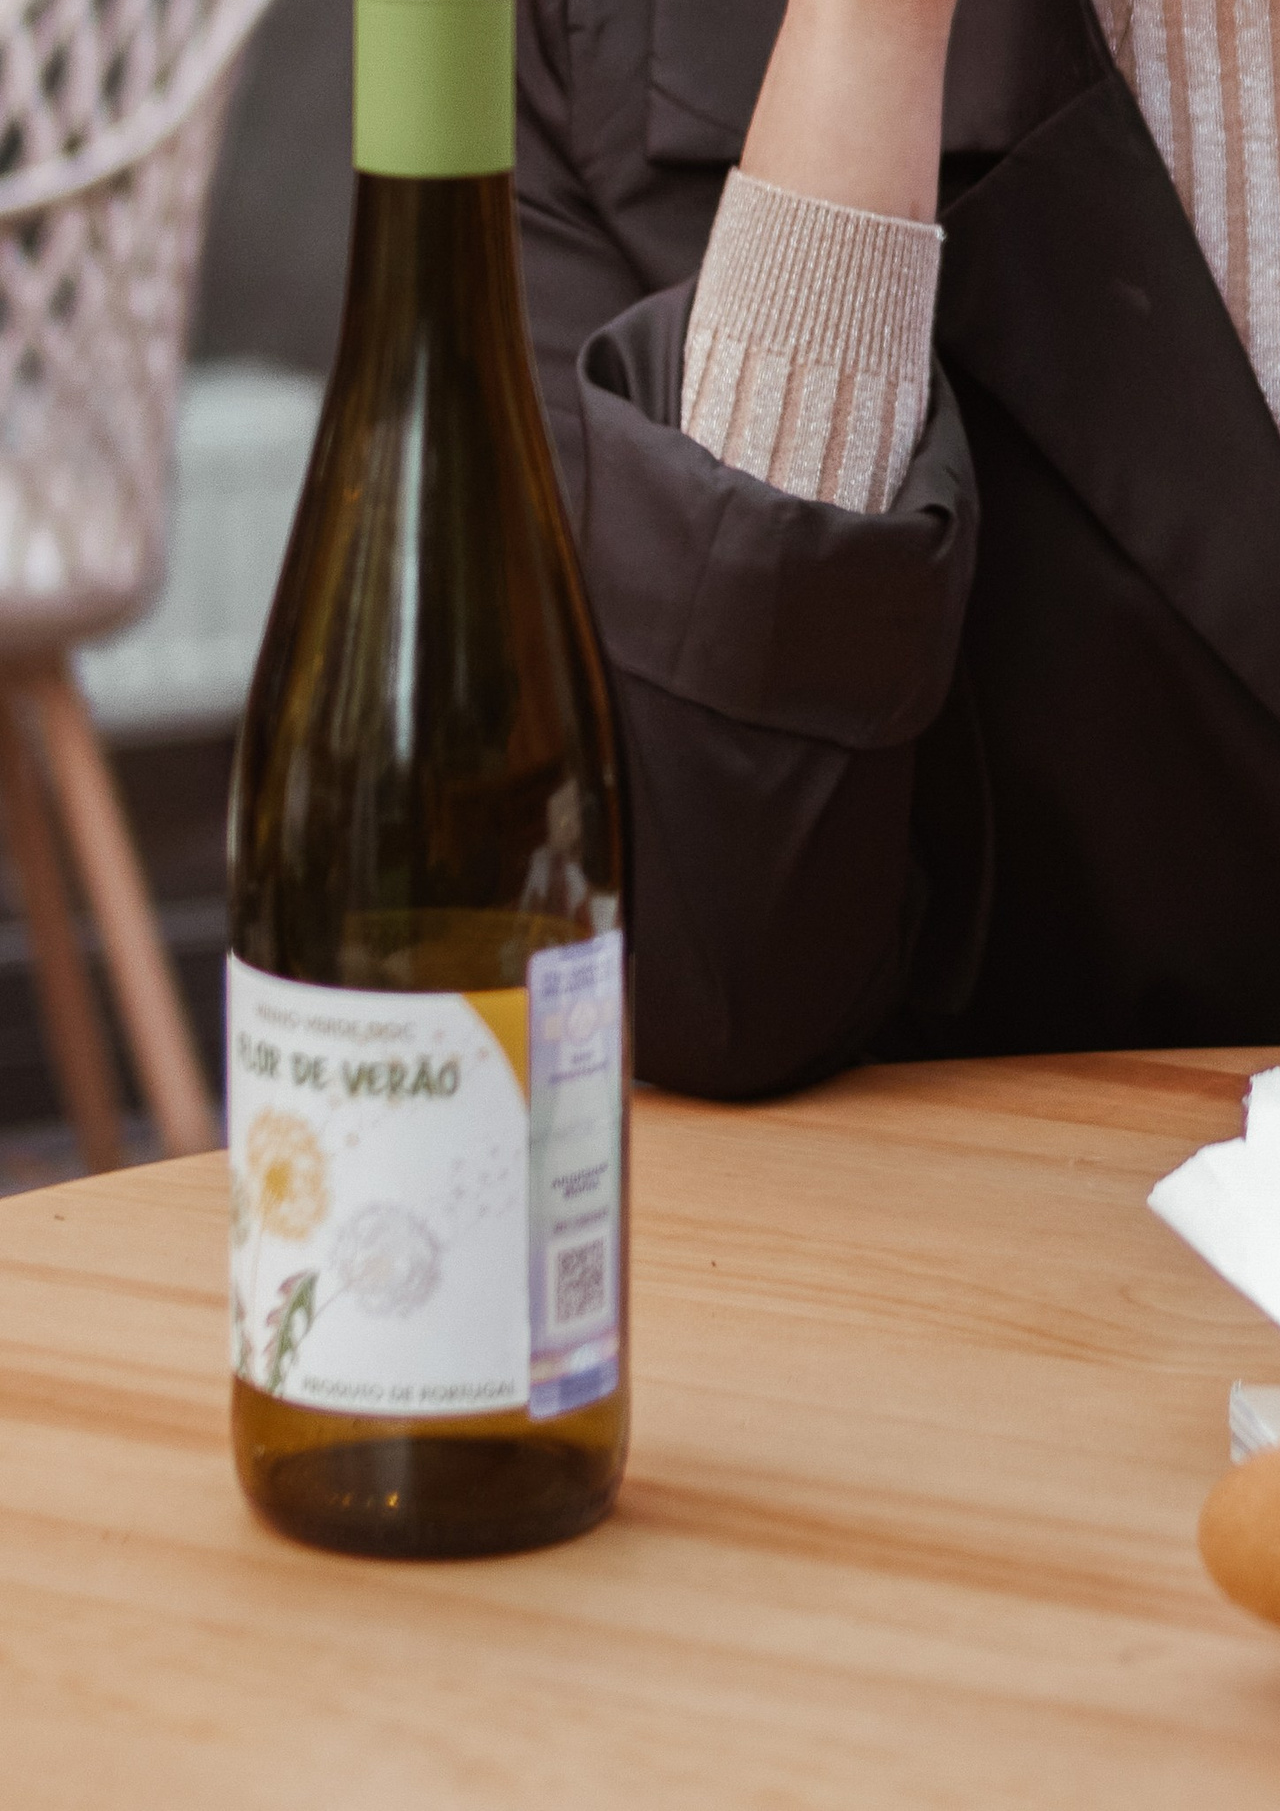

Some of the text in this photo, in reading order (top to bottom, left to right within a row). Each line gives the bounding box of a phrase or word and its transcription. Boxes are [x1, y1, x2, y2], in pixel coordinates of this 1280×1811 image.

[292, 1053, 328, 1090] DE
[342, 1053, 460, 1096] VERÃO
[303, 1376, 516, 1401] PRODUTO DE PORTUGAL
